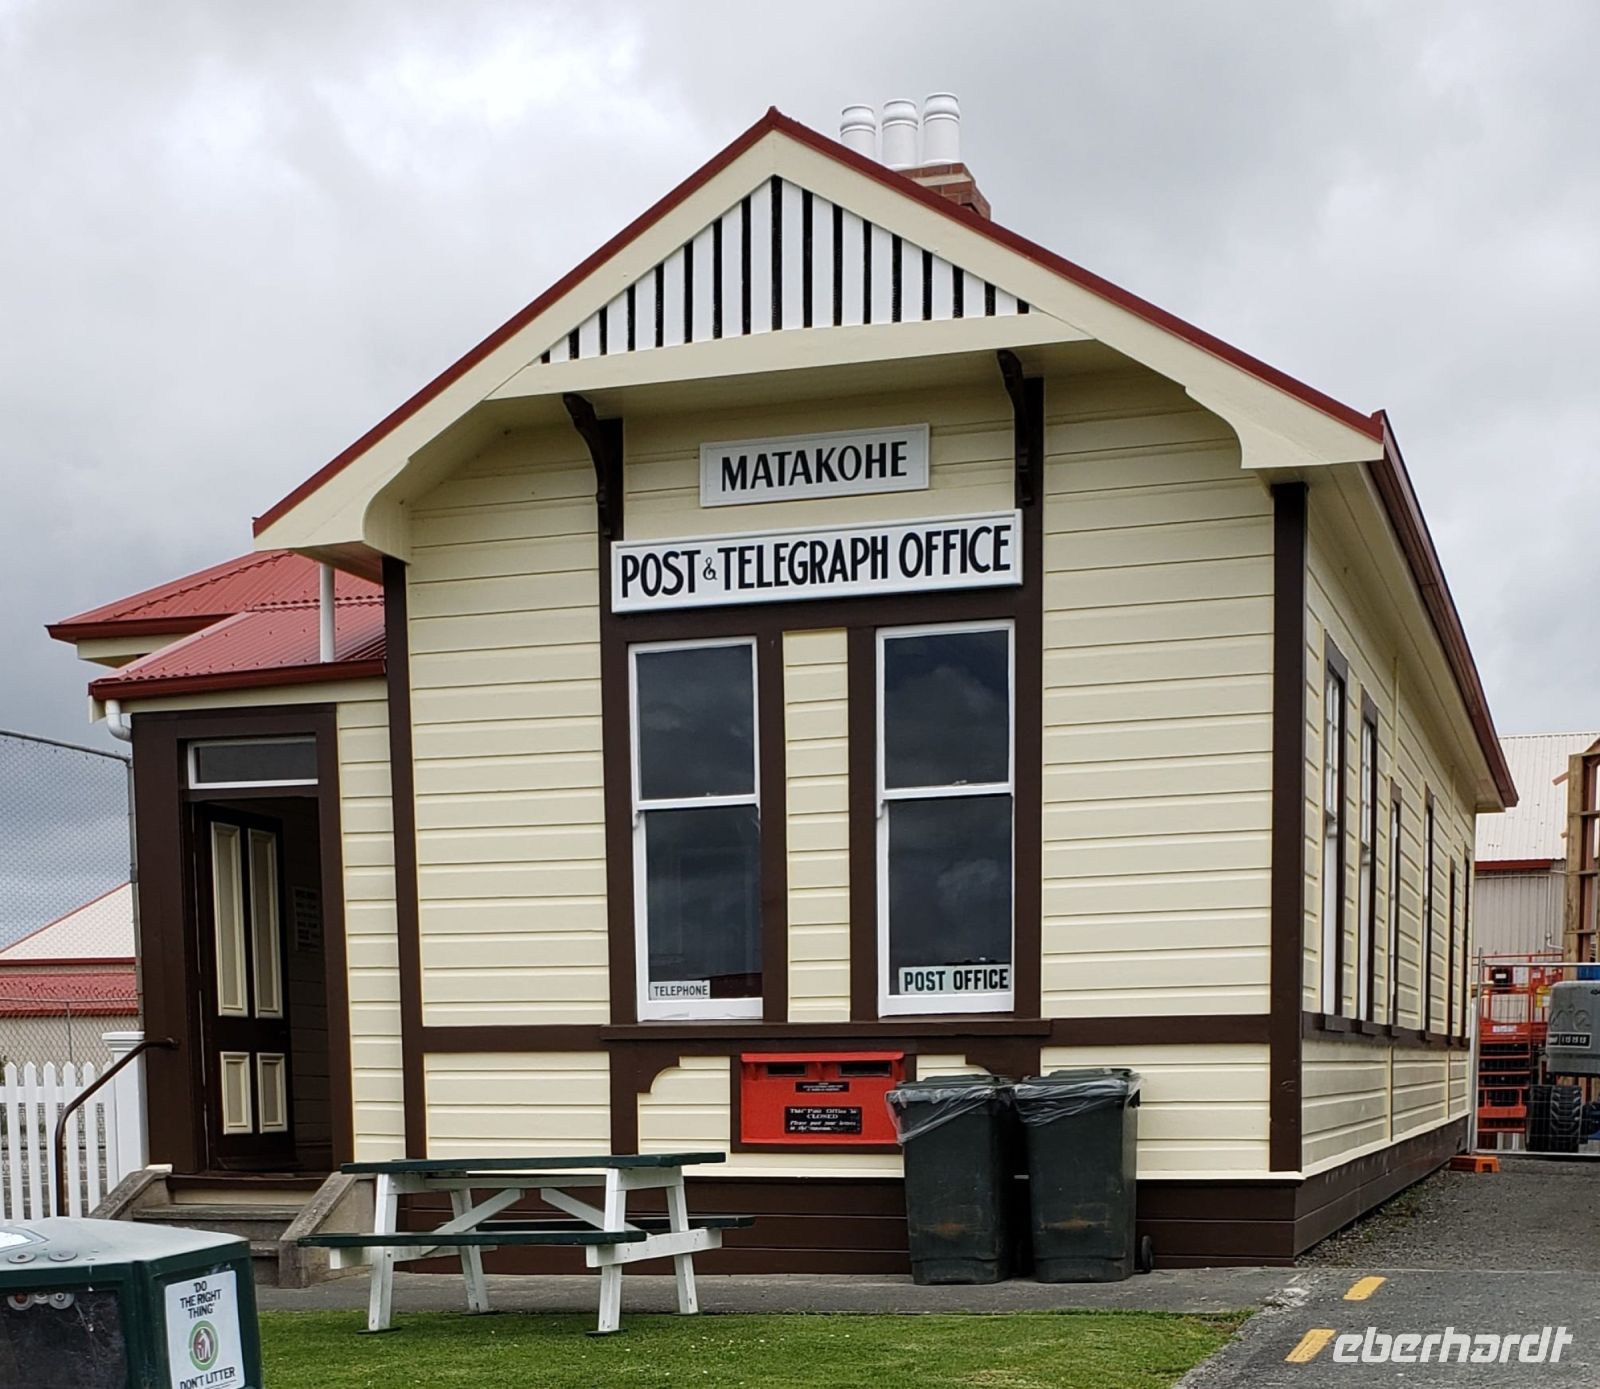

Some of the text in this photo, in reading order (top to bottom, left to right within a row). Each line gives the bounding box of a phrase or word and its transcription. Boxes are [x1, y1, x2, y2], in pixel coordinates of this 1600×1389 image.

[722, 441, 907, 492] MATAKOHE
[622, 525, 1012, 598] POST & TELEGRAPH OFFICE
[654, 985, 708, 997] TELEPHONE
[904, 968, 1009, 992] POST OFFICE
[180, 1289, 222, 1309] THE RIGHT
[206, 1366, 235, 1384] LITTER
